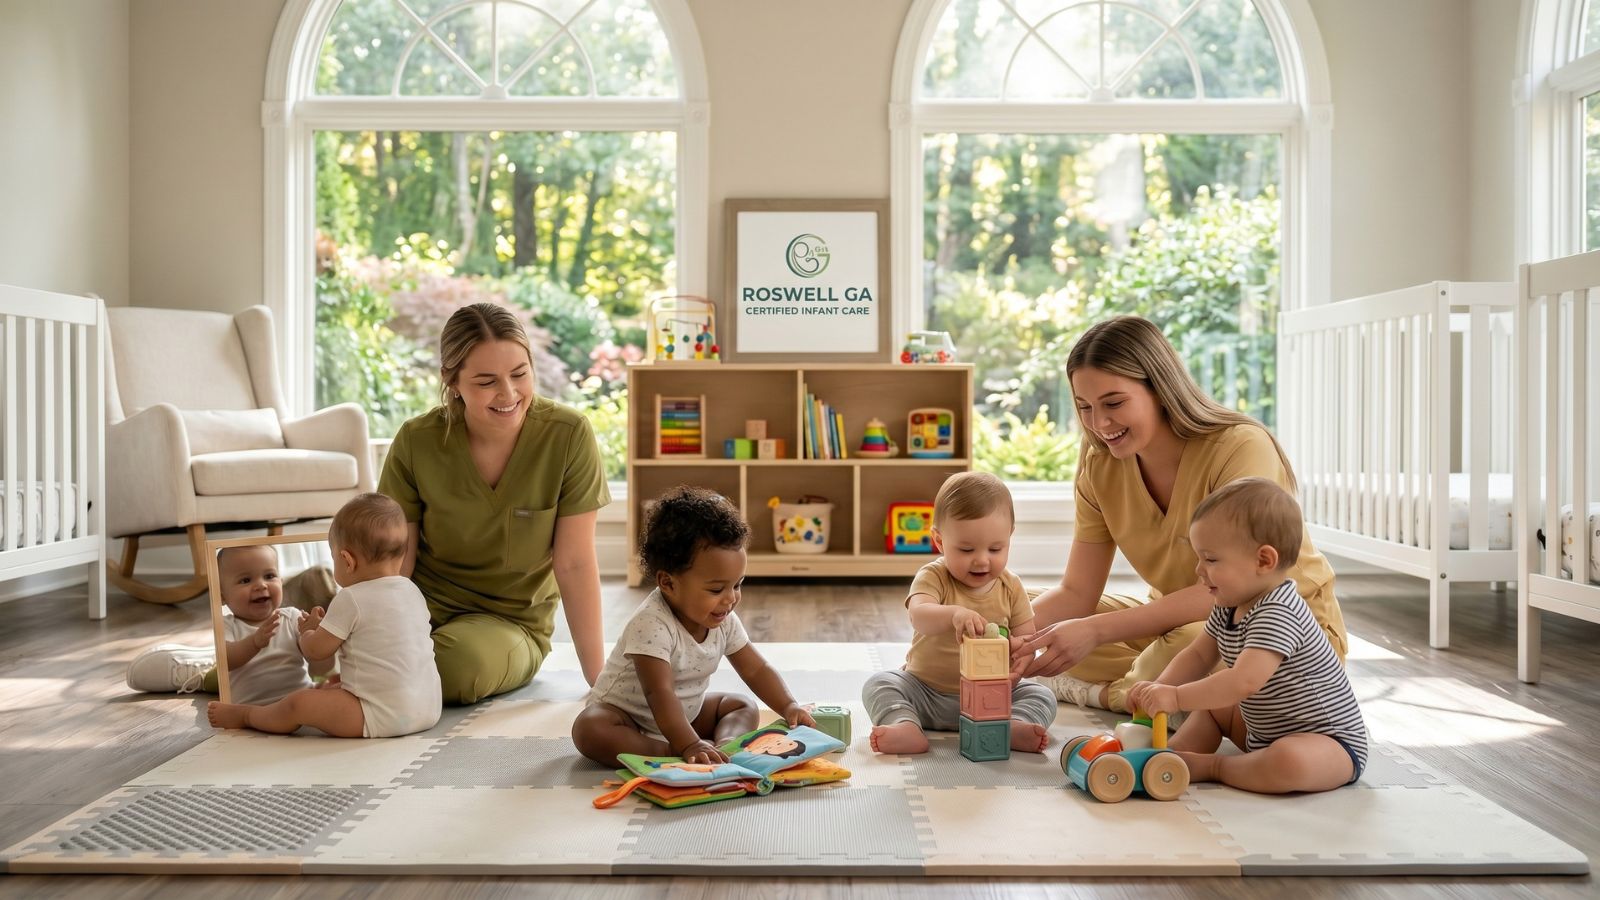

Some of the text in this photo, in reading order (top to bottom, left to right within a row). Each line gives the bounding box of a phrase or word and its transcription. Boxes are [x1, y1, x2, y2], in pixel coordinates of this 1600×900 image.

[742, 287, 873, 302] ROSWELL GA
[745, 307, 870, 315] CERTIFIED INFANT CARE
